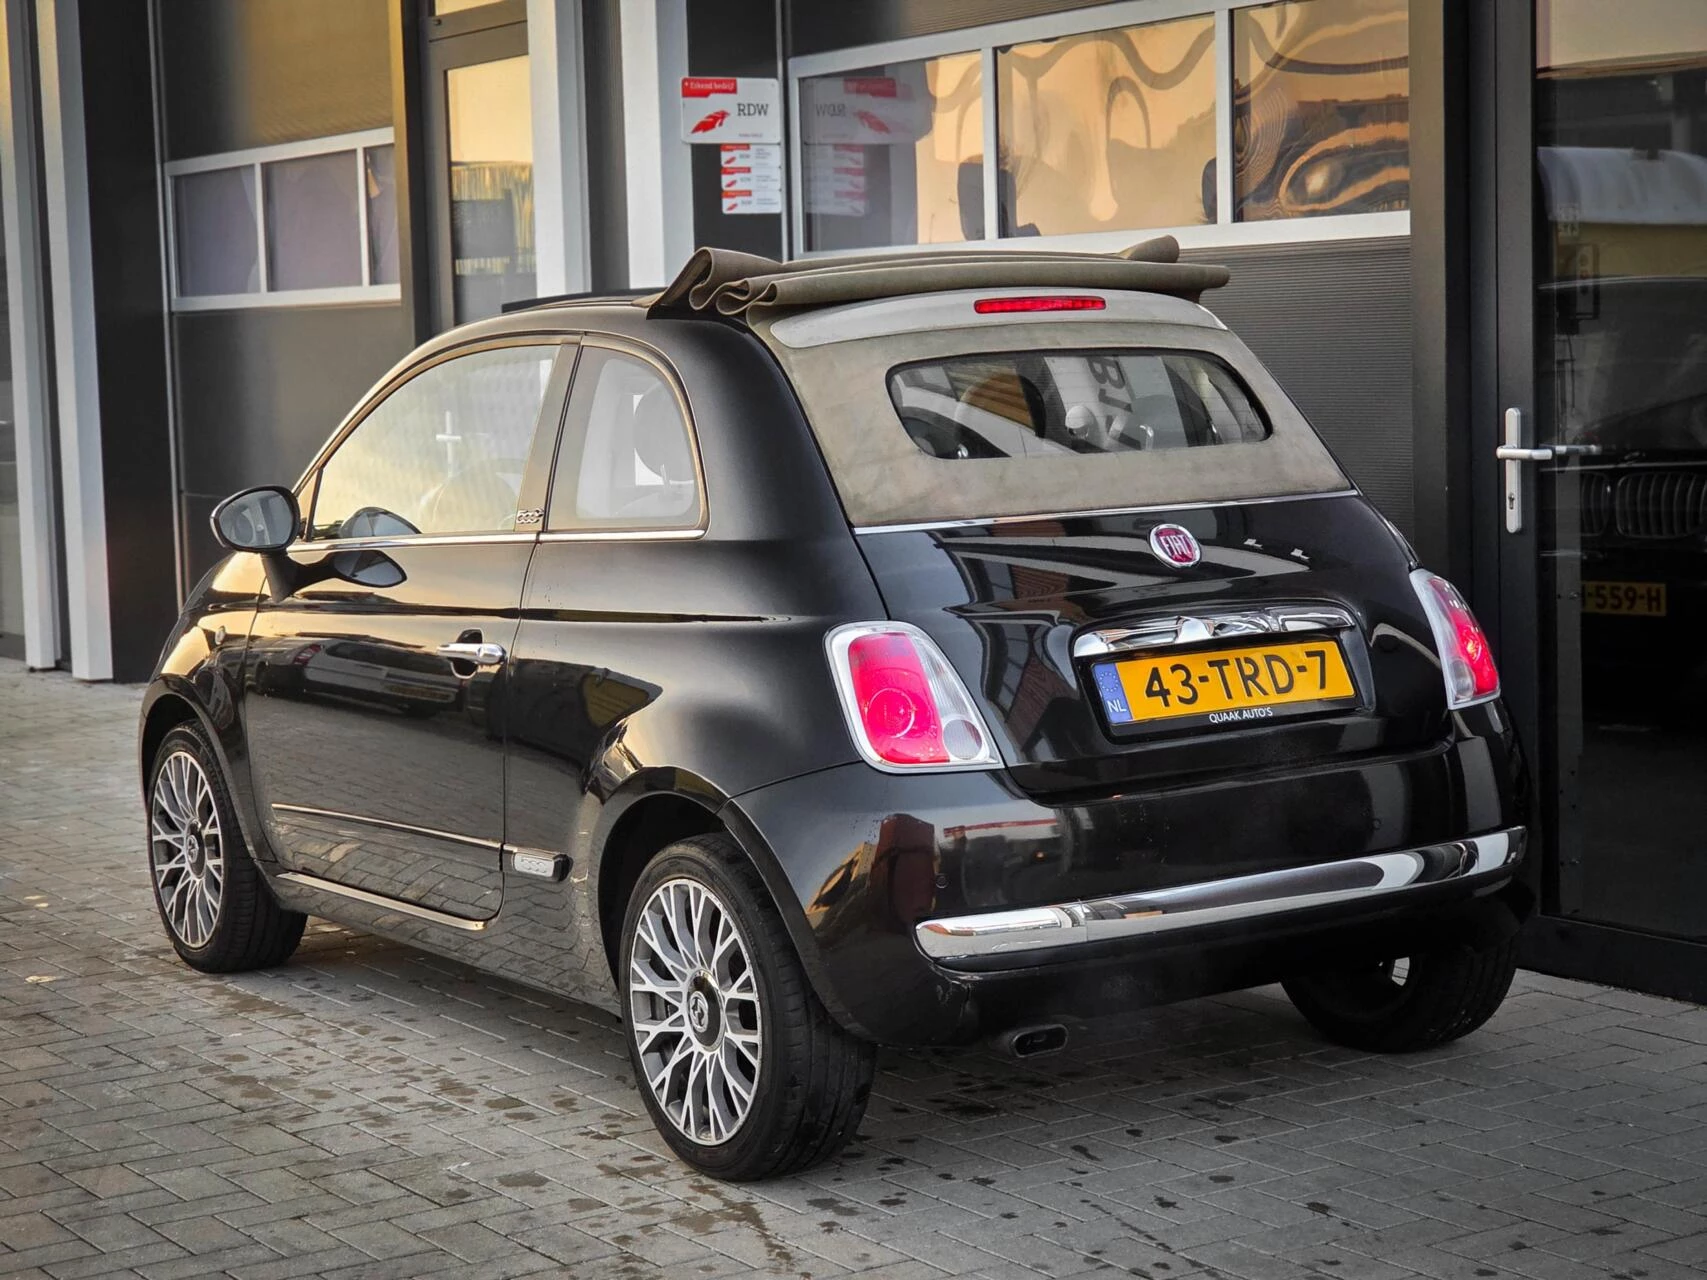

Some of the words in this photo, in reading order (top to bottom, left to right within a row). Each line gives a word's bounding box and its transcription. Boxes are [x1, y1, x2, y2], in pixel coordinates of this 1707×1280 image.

[737, 103, 769, 117] RDW
[1160, 534, 1191, 557] FIAT
[1582, 584, 1661, 612] -559-H
[1145, 650, 1326, 708] 43-TRD-7
[1107, 699, 1127, 713] NL
[1209, 711, 1241, 723] QUAAK
[1242, 707, 1273, 719] AUTO'S
